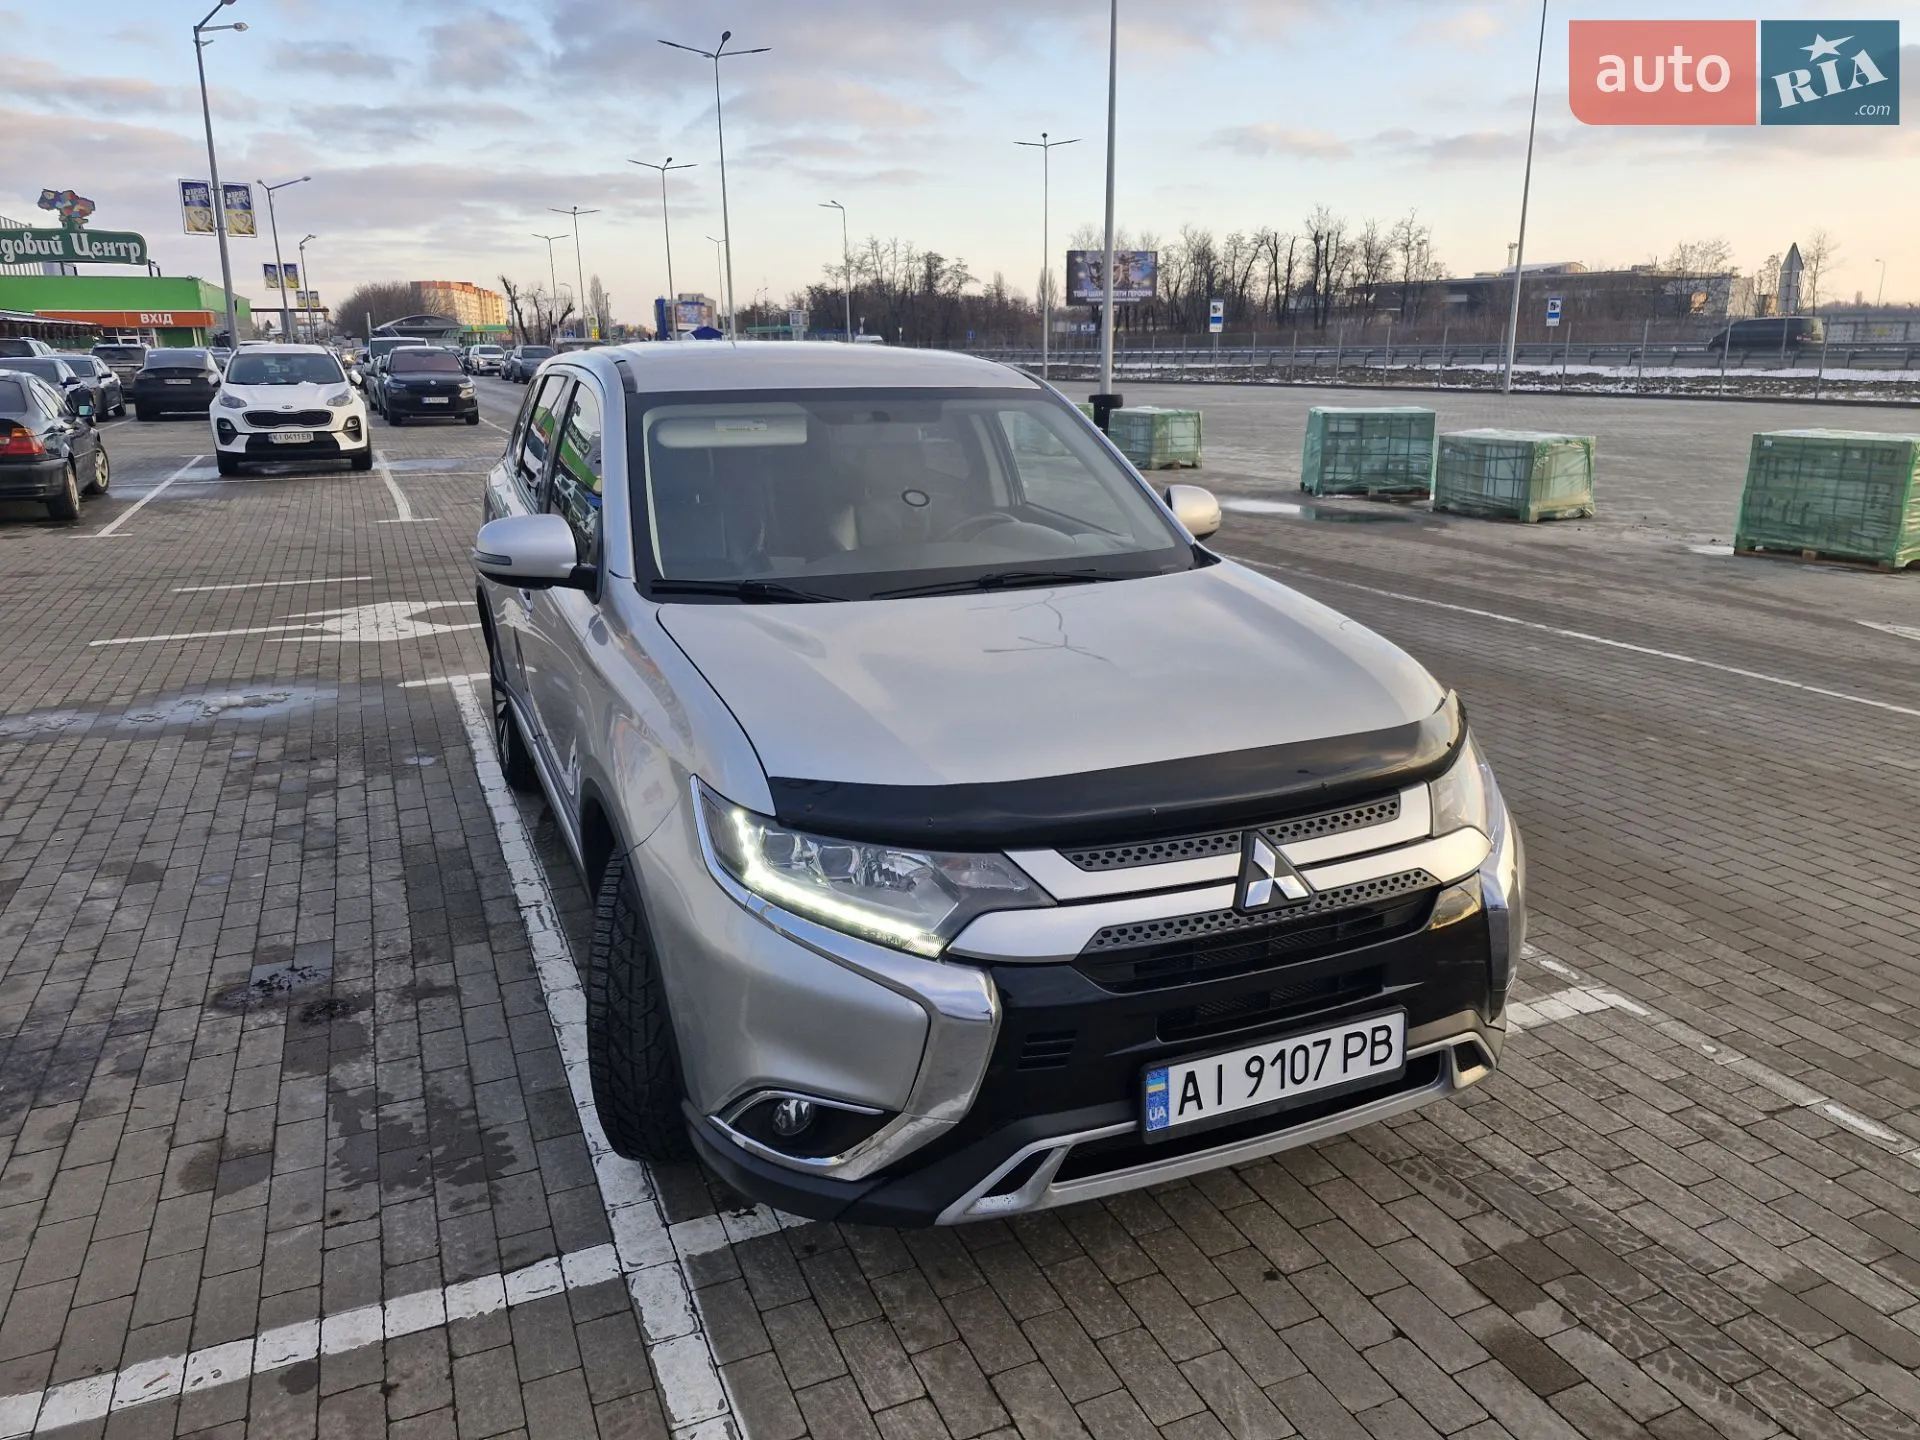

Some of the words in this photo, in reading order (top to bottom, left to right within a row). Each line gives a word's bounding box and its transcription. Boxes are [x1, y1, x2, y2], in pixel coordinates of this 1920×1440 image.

[0, 231, 64, 262] довий
[69, 232, 140, 263] Центр
[140, 313, 174, 325] ВХІД
[1178, 1064, 1223, 1116] AI
[1245, 1037, 1332, 1099] 9107
[1342, 1024, 1393, 1074] PB
[1149, 1107, 1168, 1121] UA
